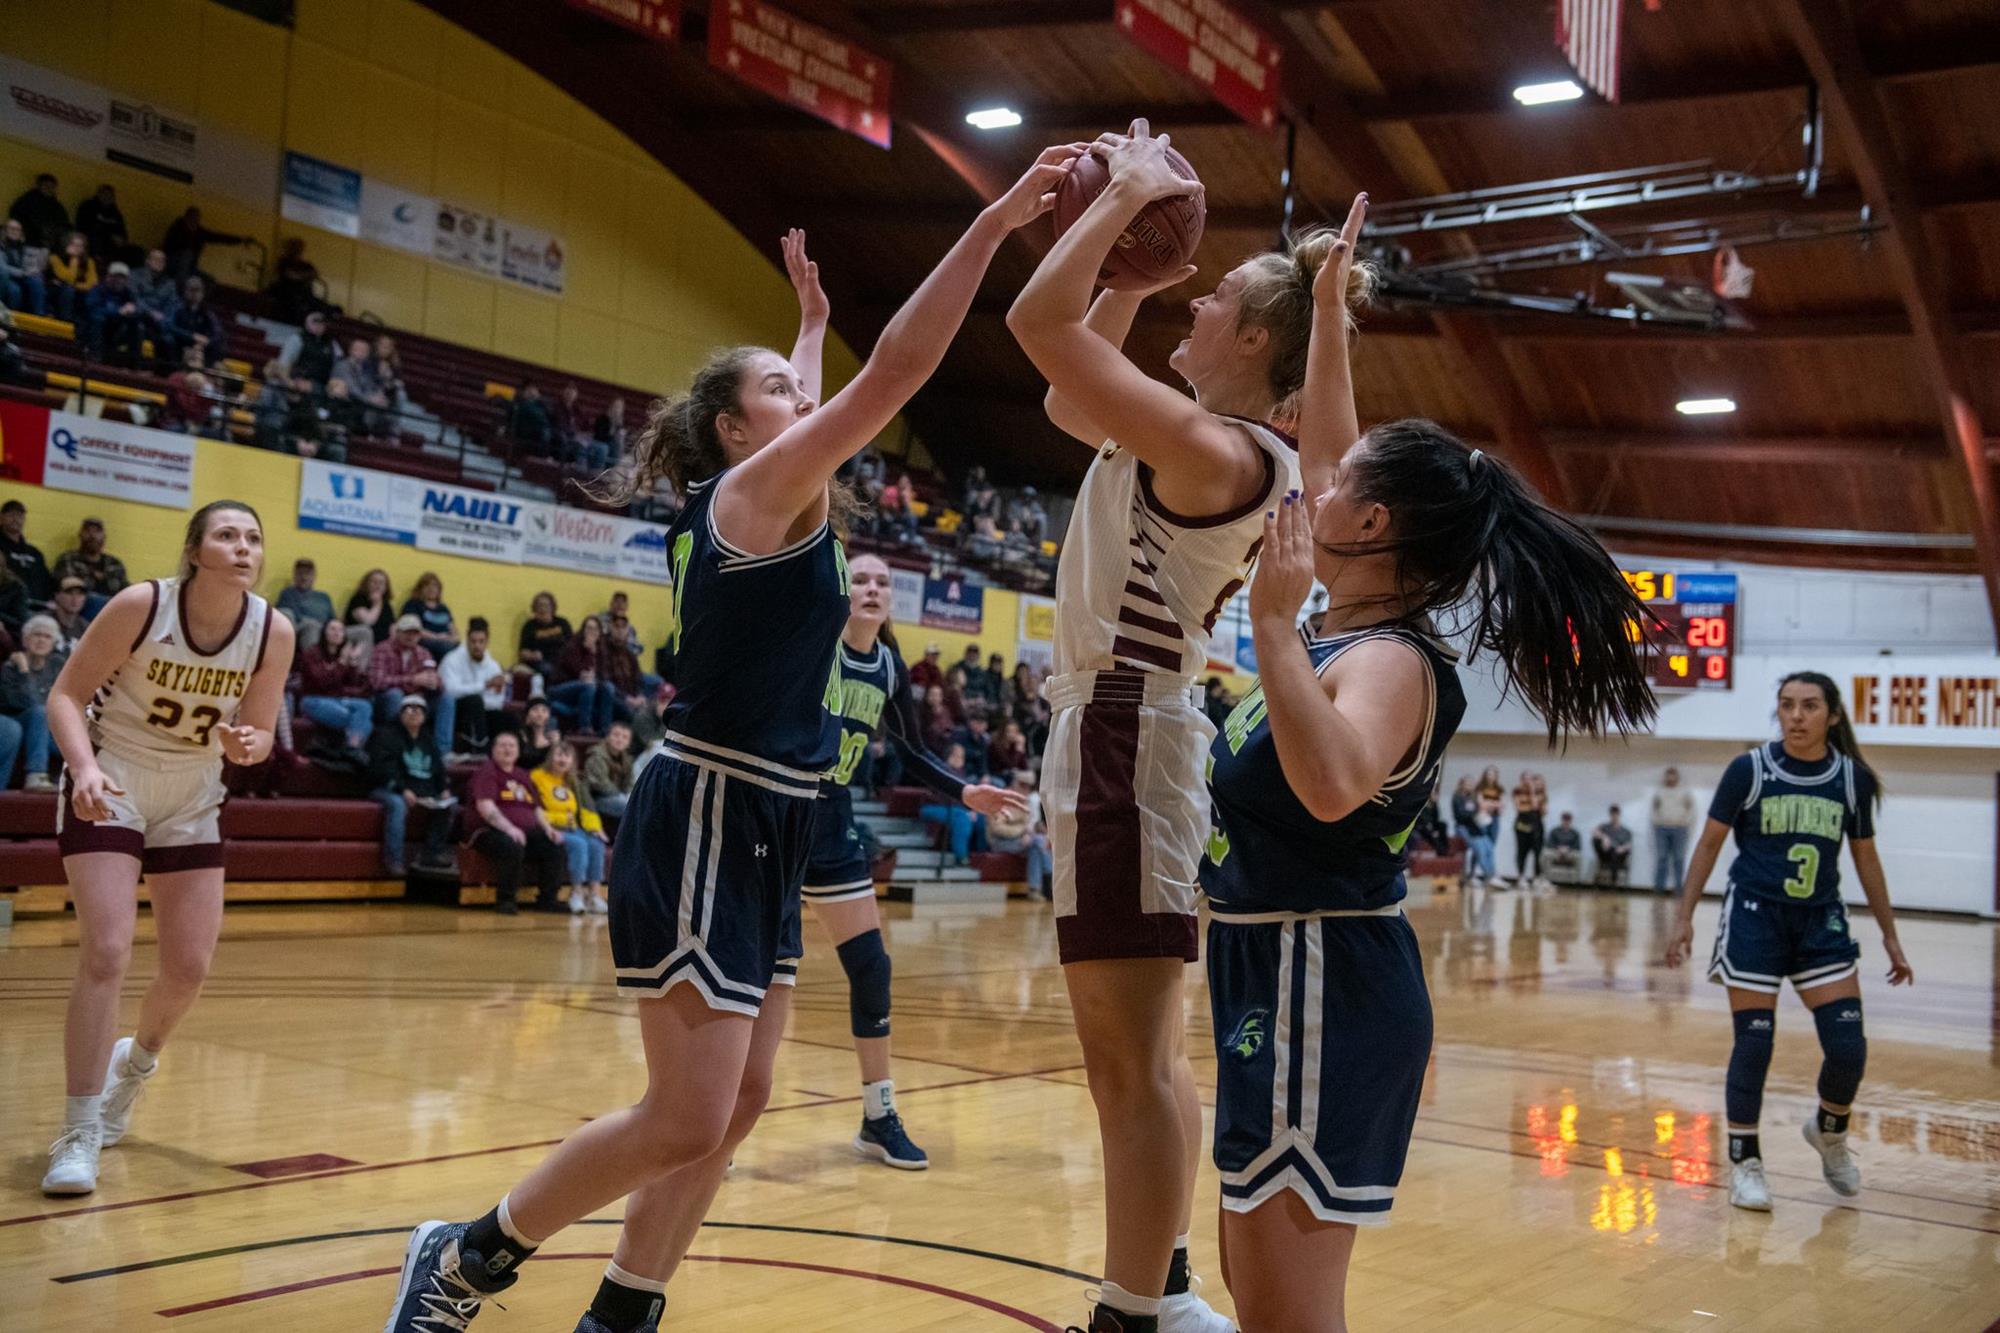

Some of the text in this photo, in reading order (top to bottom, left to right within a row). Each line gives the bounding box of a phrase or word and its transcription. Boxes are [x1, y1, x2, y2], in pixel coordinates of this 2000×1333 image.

[80, 436, 191, 464] OFFICE EQUIPMENT
[303, 498, 386, 523] AQUATANA
[422, 489, 523, 526] NAULT
[553, 509, 615, 544] Western
[1681, 603, 1724, 618] GUEST
[1688, 617, 1727, 647] 20
[147, 658, 246, 698] SKYLIGHTS
[1669, 655, 1689, 677] 4
[1706, 655, 1726, 679] 0
[1853, 677, 1879, 724] WE
[1888, 677, 1927, 725] ARE
[147, 697, 222, 747] 23
[1760, 793, 1844, 842] PROVIDENCE
[1783, 843, 1820, 899] 3
